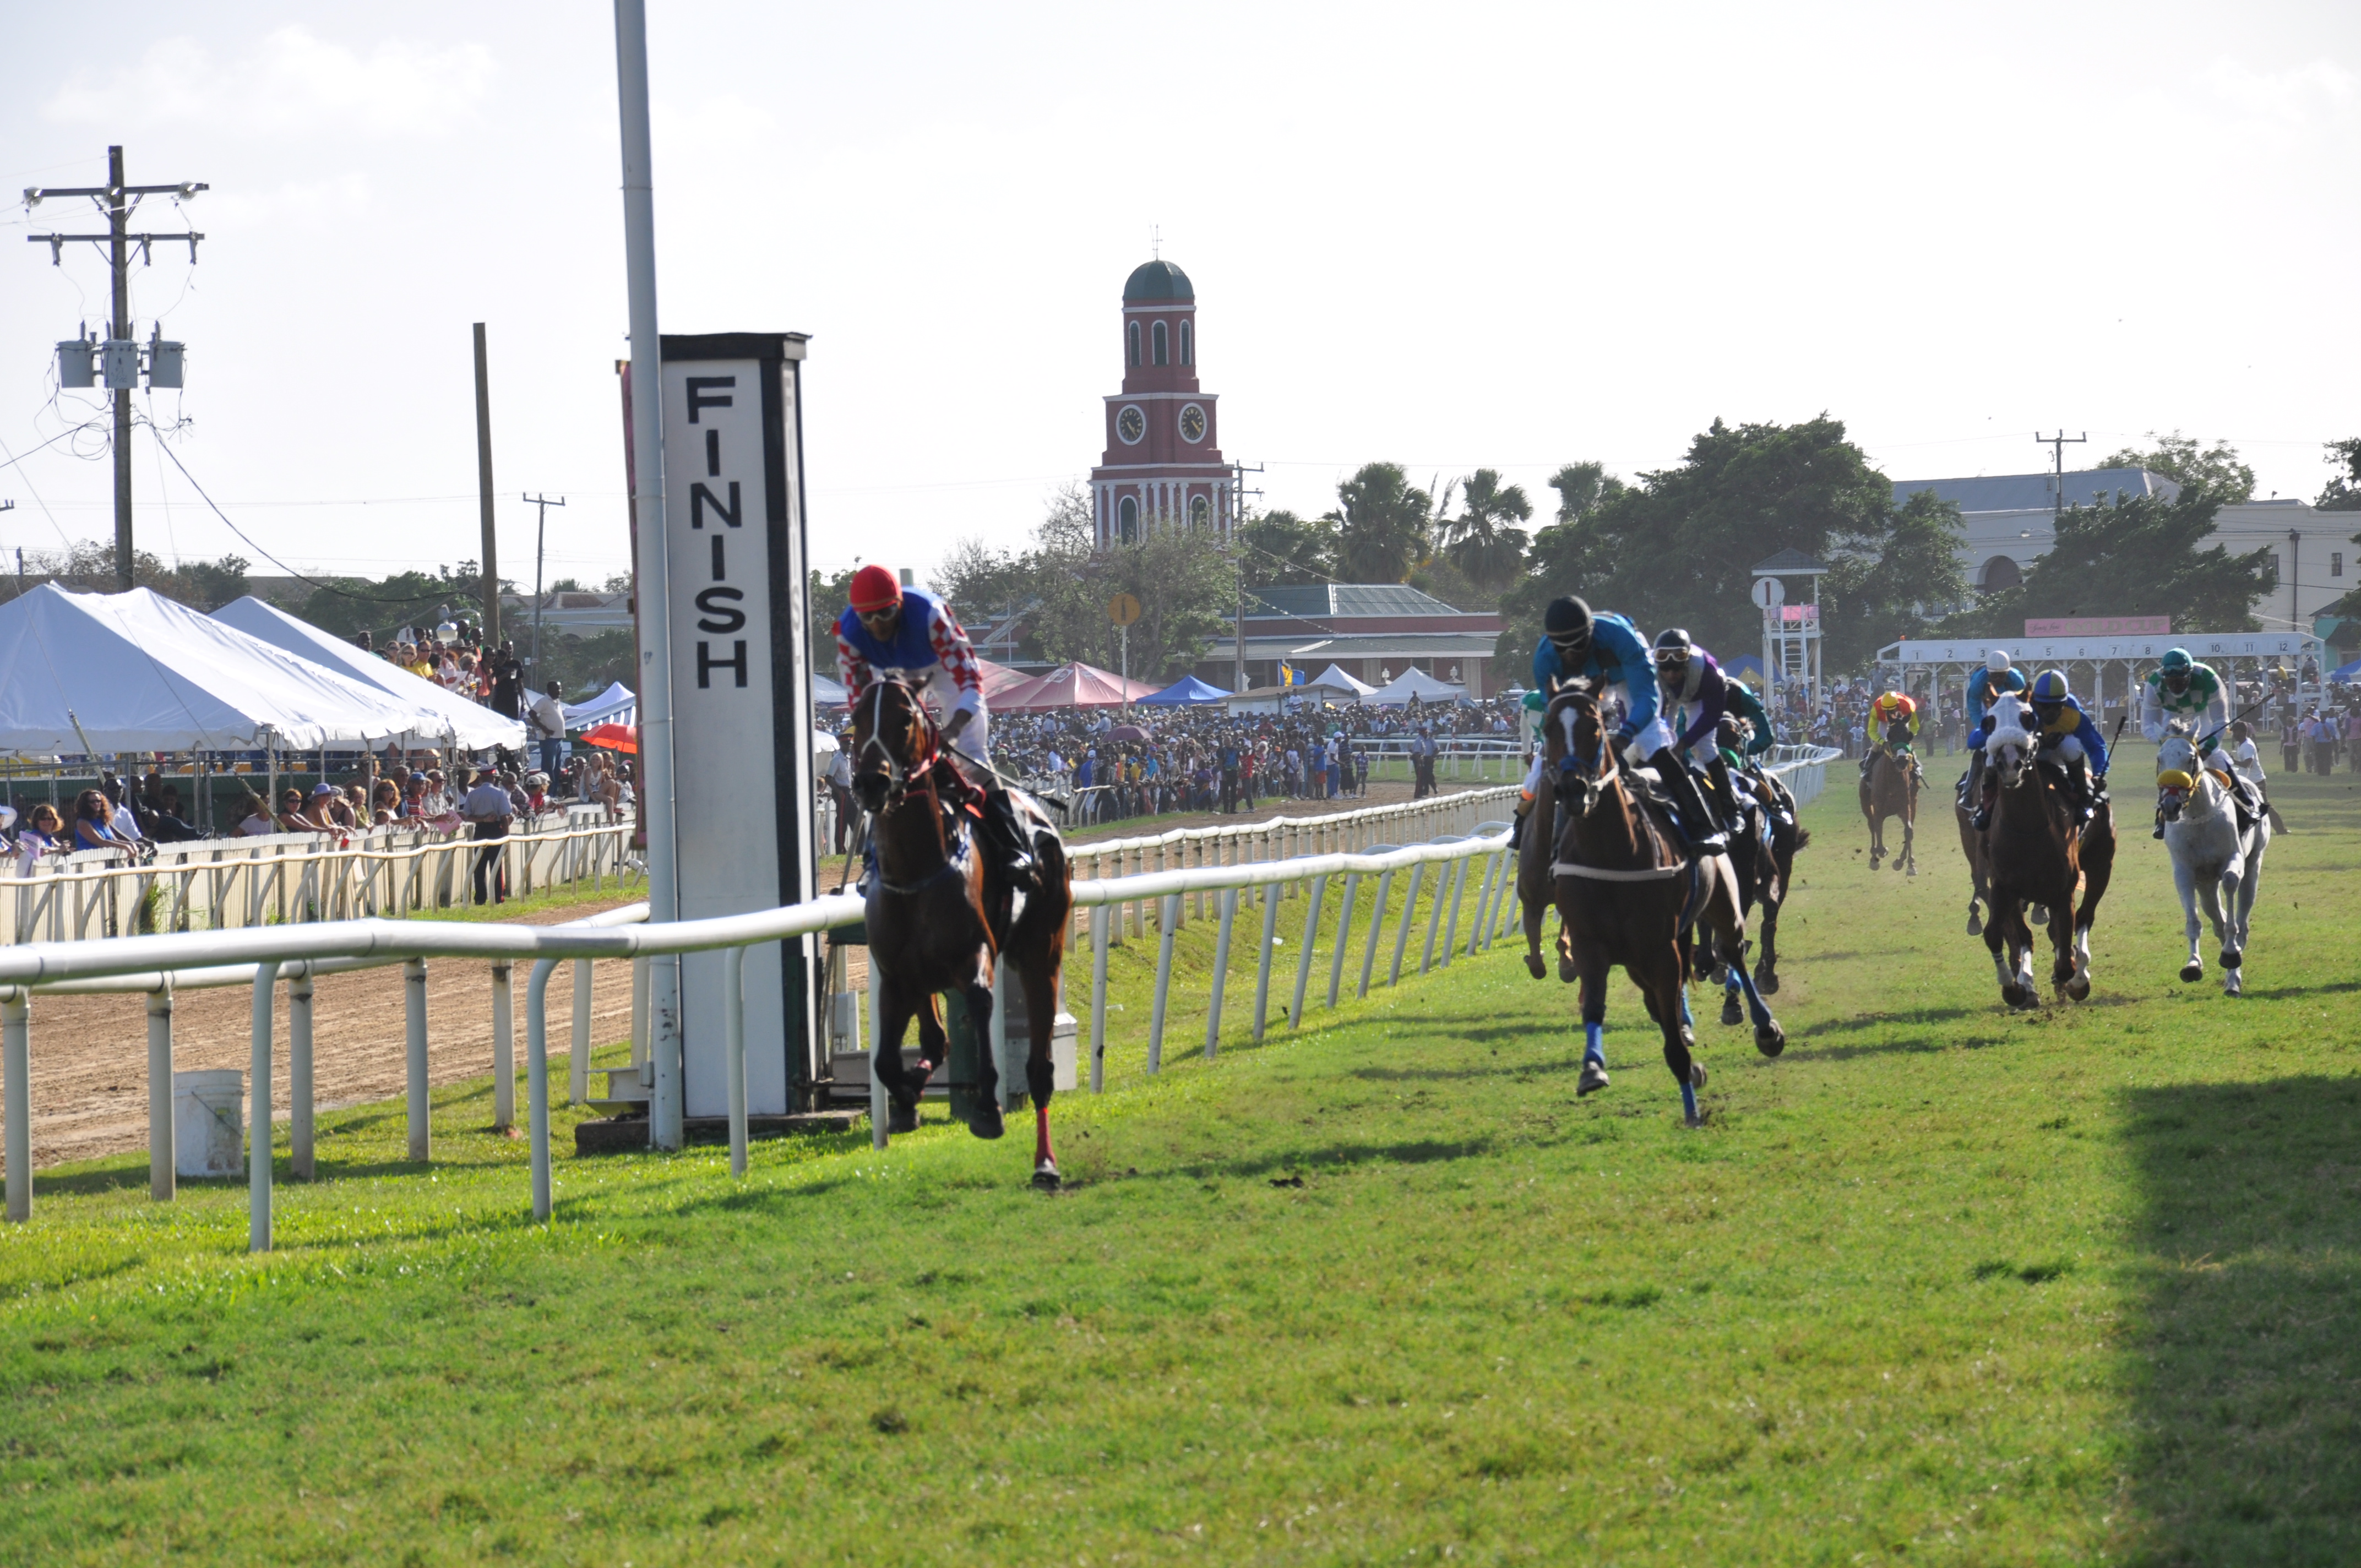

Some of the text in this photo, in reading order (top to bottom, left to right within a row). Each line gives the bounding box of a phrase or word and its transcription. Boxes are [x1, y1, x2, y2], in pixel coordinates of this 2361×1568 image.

[686, 376, 748, 689] FINISH
[2065, 620, 2124, 633] GOLD
[2126, 619, 2167, 631] CUP
[1916, 643, 2288, 660] 1 2 3 4 5 6 7 8 10 11 12
